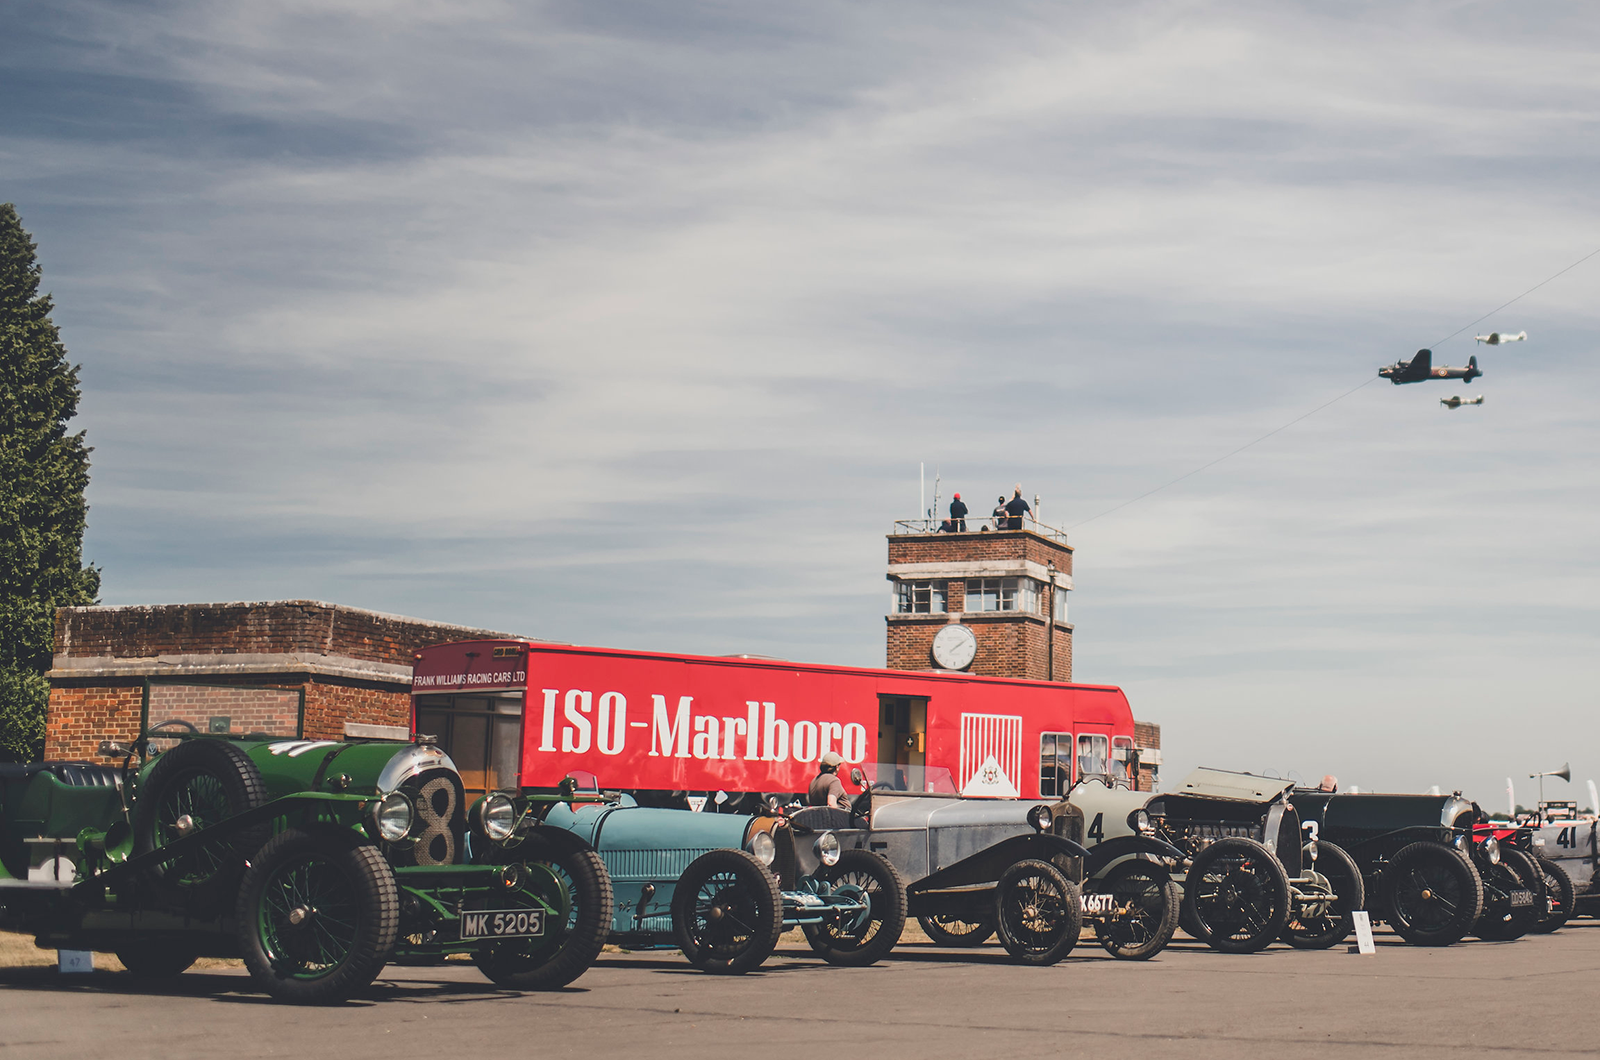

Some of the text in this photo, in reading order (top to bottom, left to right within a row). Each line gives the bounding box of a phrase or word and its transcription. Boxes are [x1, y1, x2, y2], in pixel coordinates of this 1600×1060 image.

[414, 671, 526, 686] FRANK WILLIAMS RACING CARS LTD
[538, 688, 866, 763] ISO-Marlboro
[414, 777, 456, 866] 8
[1087, 812, 1104, 843] 4
[1556, 826, 1576, 849] 41
[465, 912, 540, 936] MK 5205
